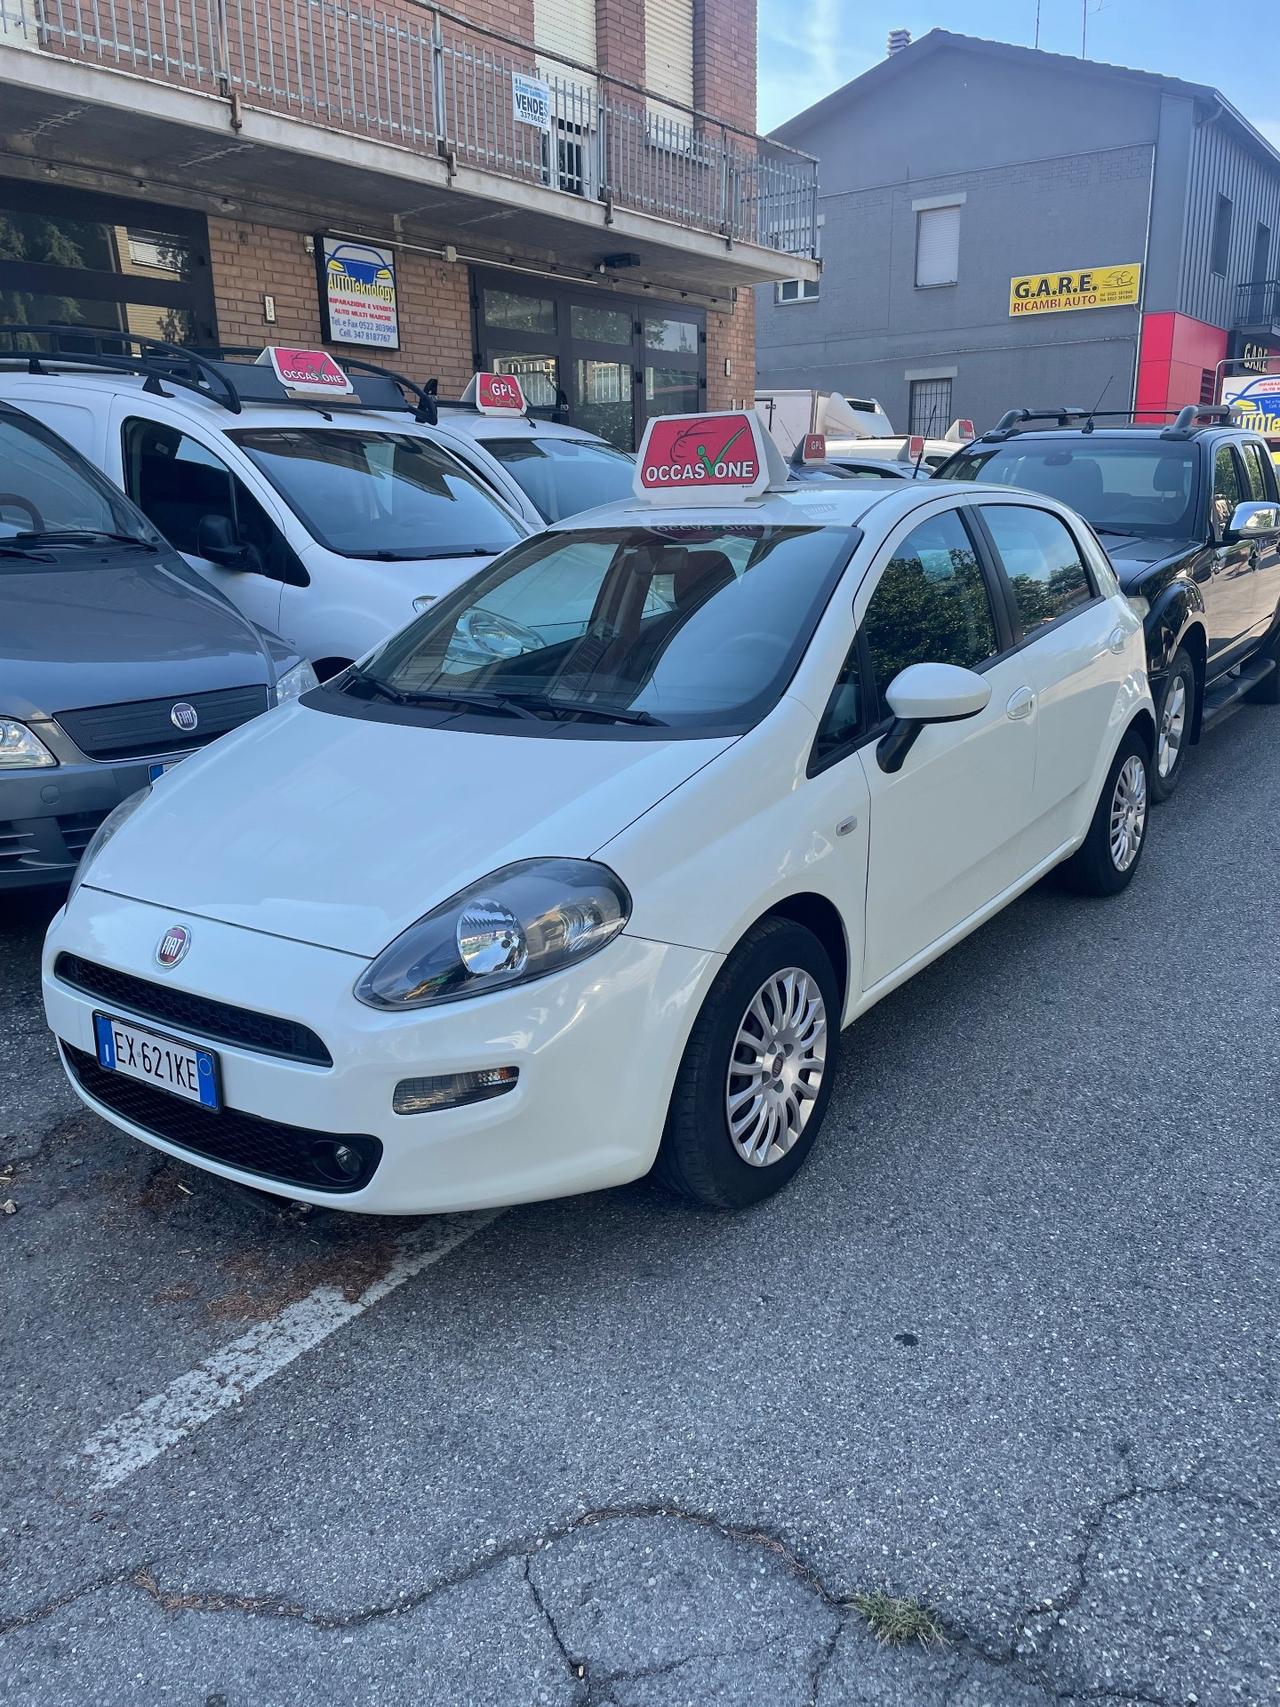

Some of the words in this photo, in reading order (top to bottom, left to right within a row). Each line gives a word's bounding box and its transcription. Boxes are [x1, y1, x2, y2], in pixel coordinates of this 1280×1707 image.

[328, 273, 395, 304] AUTOTeknology
[1014, 274, 1097, 298] G.A.R.E.
[329, 297, 367, 309] RIPARAZIONE
[372, 304, 395, 313] VENDITA
[1013, 299, 1061, 312] RICAMBI
[1064, 294, 1097, 307] AUTO
[351, 310, 368, 318] MULTI
[369, 313, 392, 321] MARCHE
[347, 319, 358, 328] Fax
[359, 320, 374, 331] 0522
[353, 330, 364, 339] 347
[491, 383, 516, 397] GPL
[811, 440, 823, 450] GPL
[176, 710, 193, 725] FIAT
[161, 936, 183, 957] FIAT
[114, 1031, 137, 1068] EX
